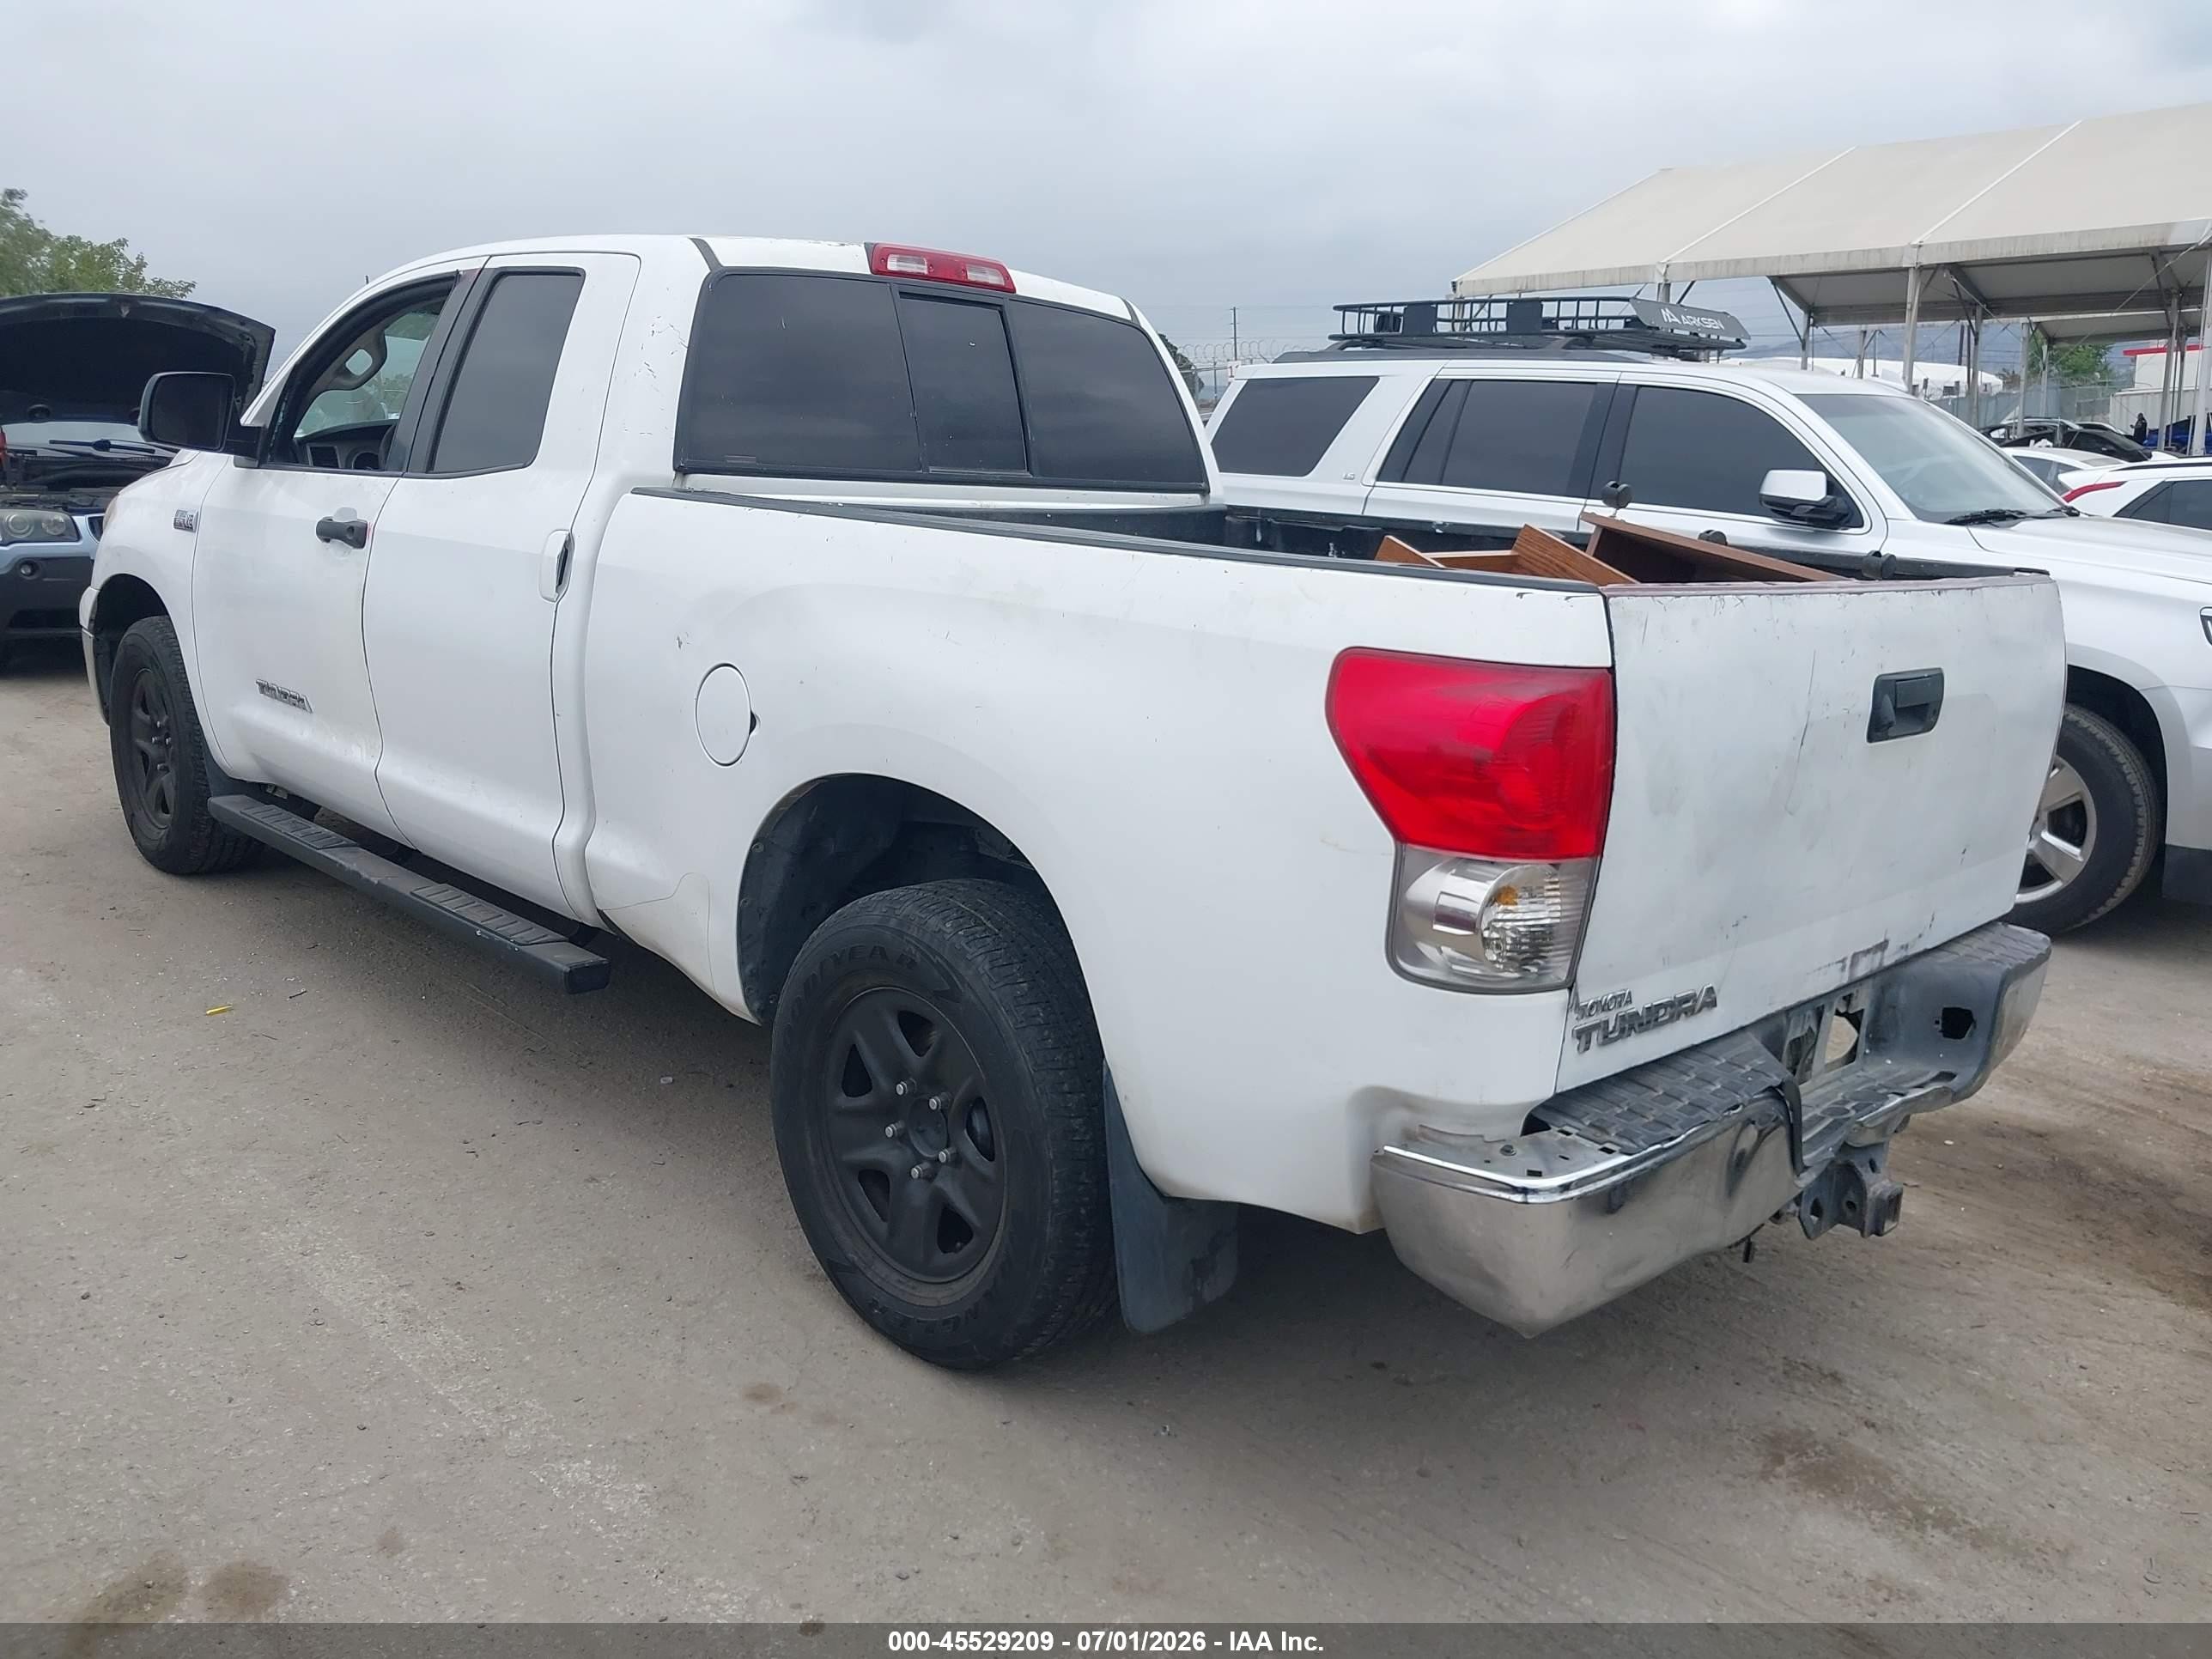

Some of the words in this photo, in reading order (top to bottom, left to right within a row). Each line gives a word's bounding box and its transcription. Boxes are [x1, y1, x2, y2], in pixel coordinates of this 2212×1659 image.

[1680, 314, 1725, 331] ARKSEN
[1571, 984, 1717, 1054] TUNDRA
[1576, 988, 1632, 1021] TOYOTA
